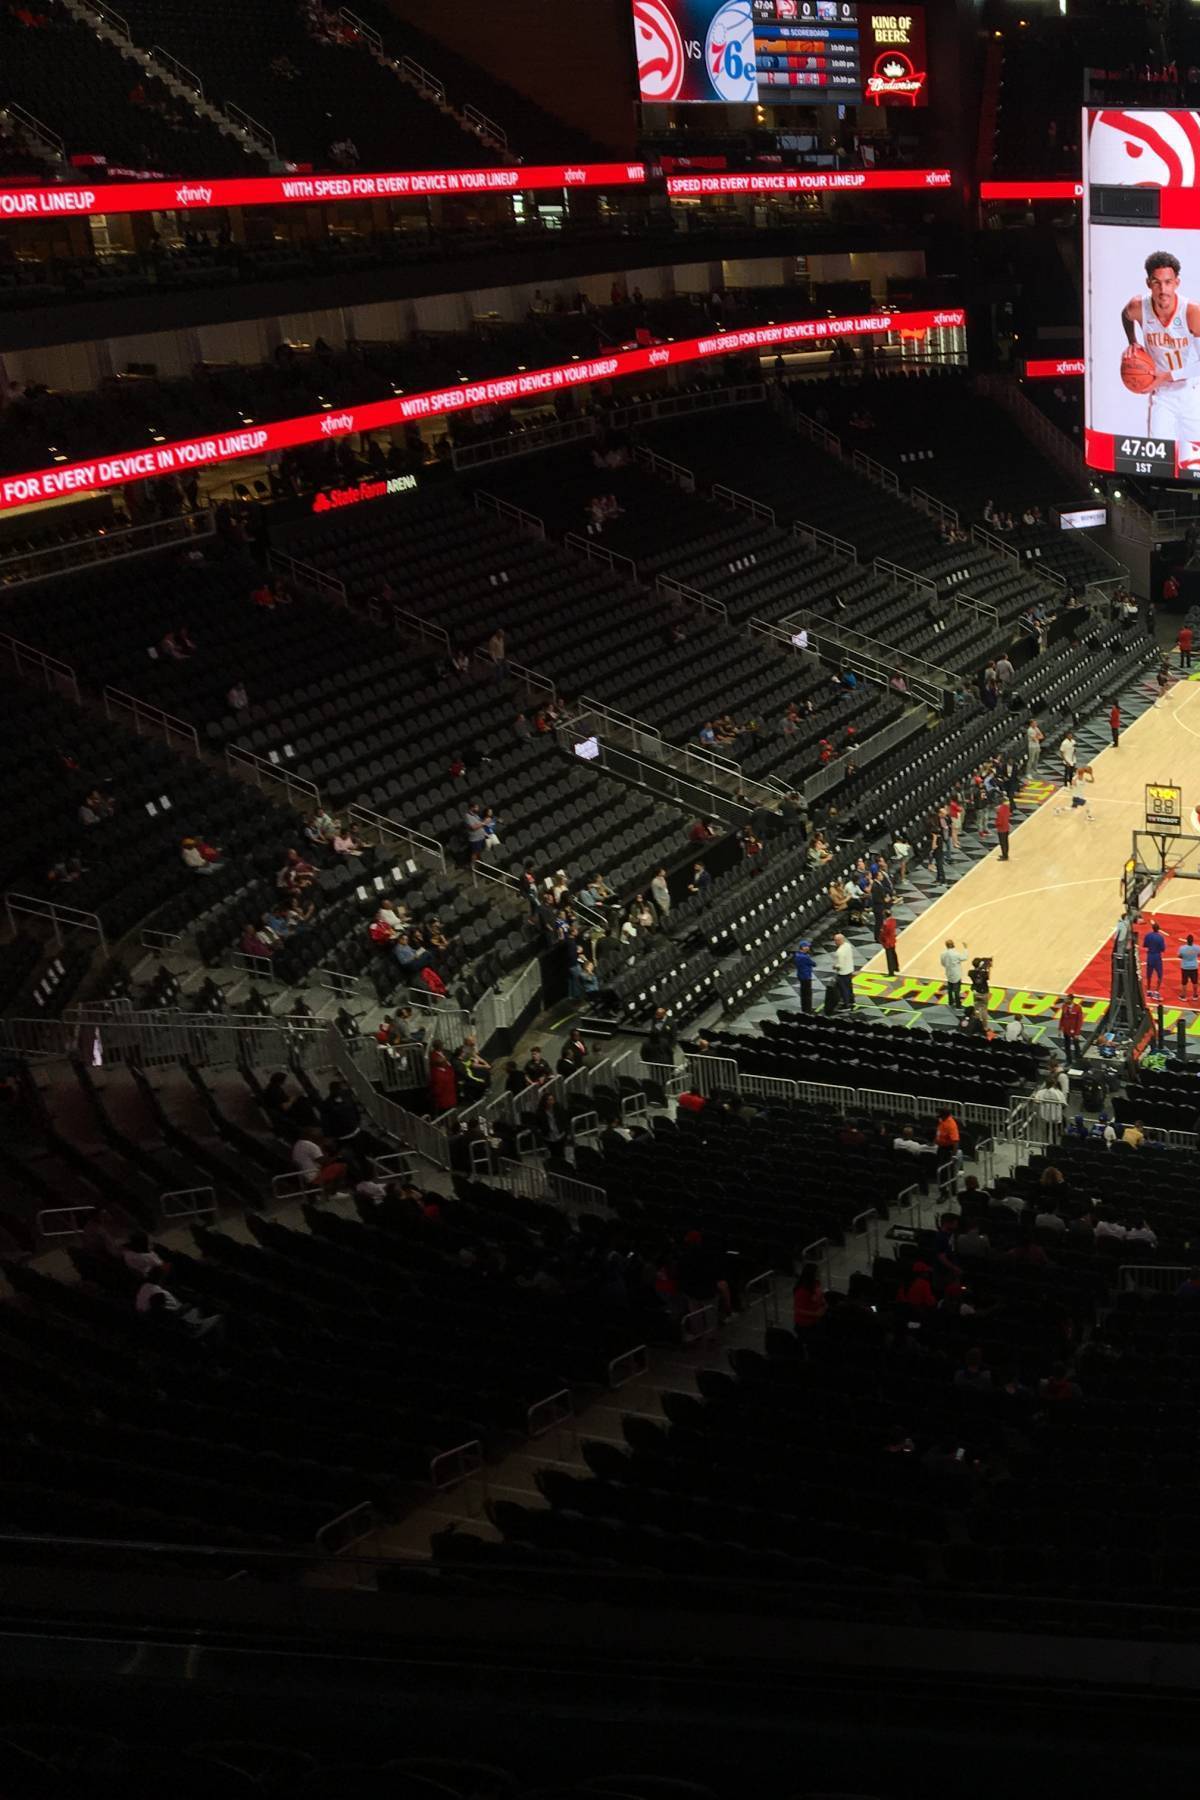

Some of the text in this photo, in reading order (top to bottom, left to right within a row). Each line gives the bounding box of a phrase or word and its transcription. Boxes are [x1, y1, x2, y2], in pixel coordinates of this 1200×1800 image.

[803, 3, 811, 15] 0
[842, 3, 850, 16] 0
[872, 16, 912, 29] KING OF
[875, 30, 910, 43] BEERS.
[684, 40, 702, 59] VS
[281, 172, 519, 197] WITH SPEED FOR EVERY DEVICE IN YOUR LINEUP
[672, 179, 700, 192] SPEED
[702, 179, 720, 190] FOR
[720, 177, 749, 189] EVERY
[751, 177, 785, 189] DEVICE
[787, 176, 797, 188] IN
[799, 175, 827, 187] YOUR
[829, 174, 866, 187] LINEUP
[40, 191, 95, 211] LINEUP
[175, 185, 212, 206] xfinity
[934, 312, 962, 326] xfinity
[698, 317, 891, 354] WITH SPEED FOR EVERY DEVICE IN YOUR LINEUP
[648, 349, 670, 366] xfinity
[1165, 350, 1182, 370] 11
[400, 359, 618, 416] WITH SPEED FOR EVERY DEVICE IN YOUR LINEUP
[320, 413, 354, 435] xfinity
[1121, 440, 1167, 460] 47:04
[3, 478, 42, 501] FOR
[42, 466, 96, 493] EVERY
[98, 453, 156, 481] DEVICE
[157, 449, 174, 468] IN
[175, 441, 217, 463] YOUR
[218, 431, 268, 455] LINEUP
[1135, 462, 1152, 473] 1ST
[386, 474, 417, 494] ARENA
